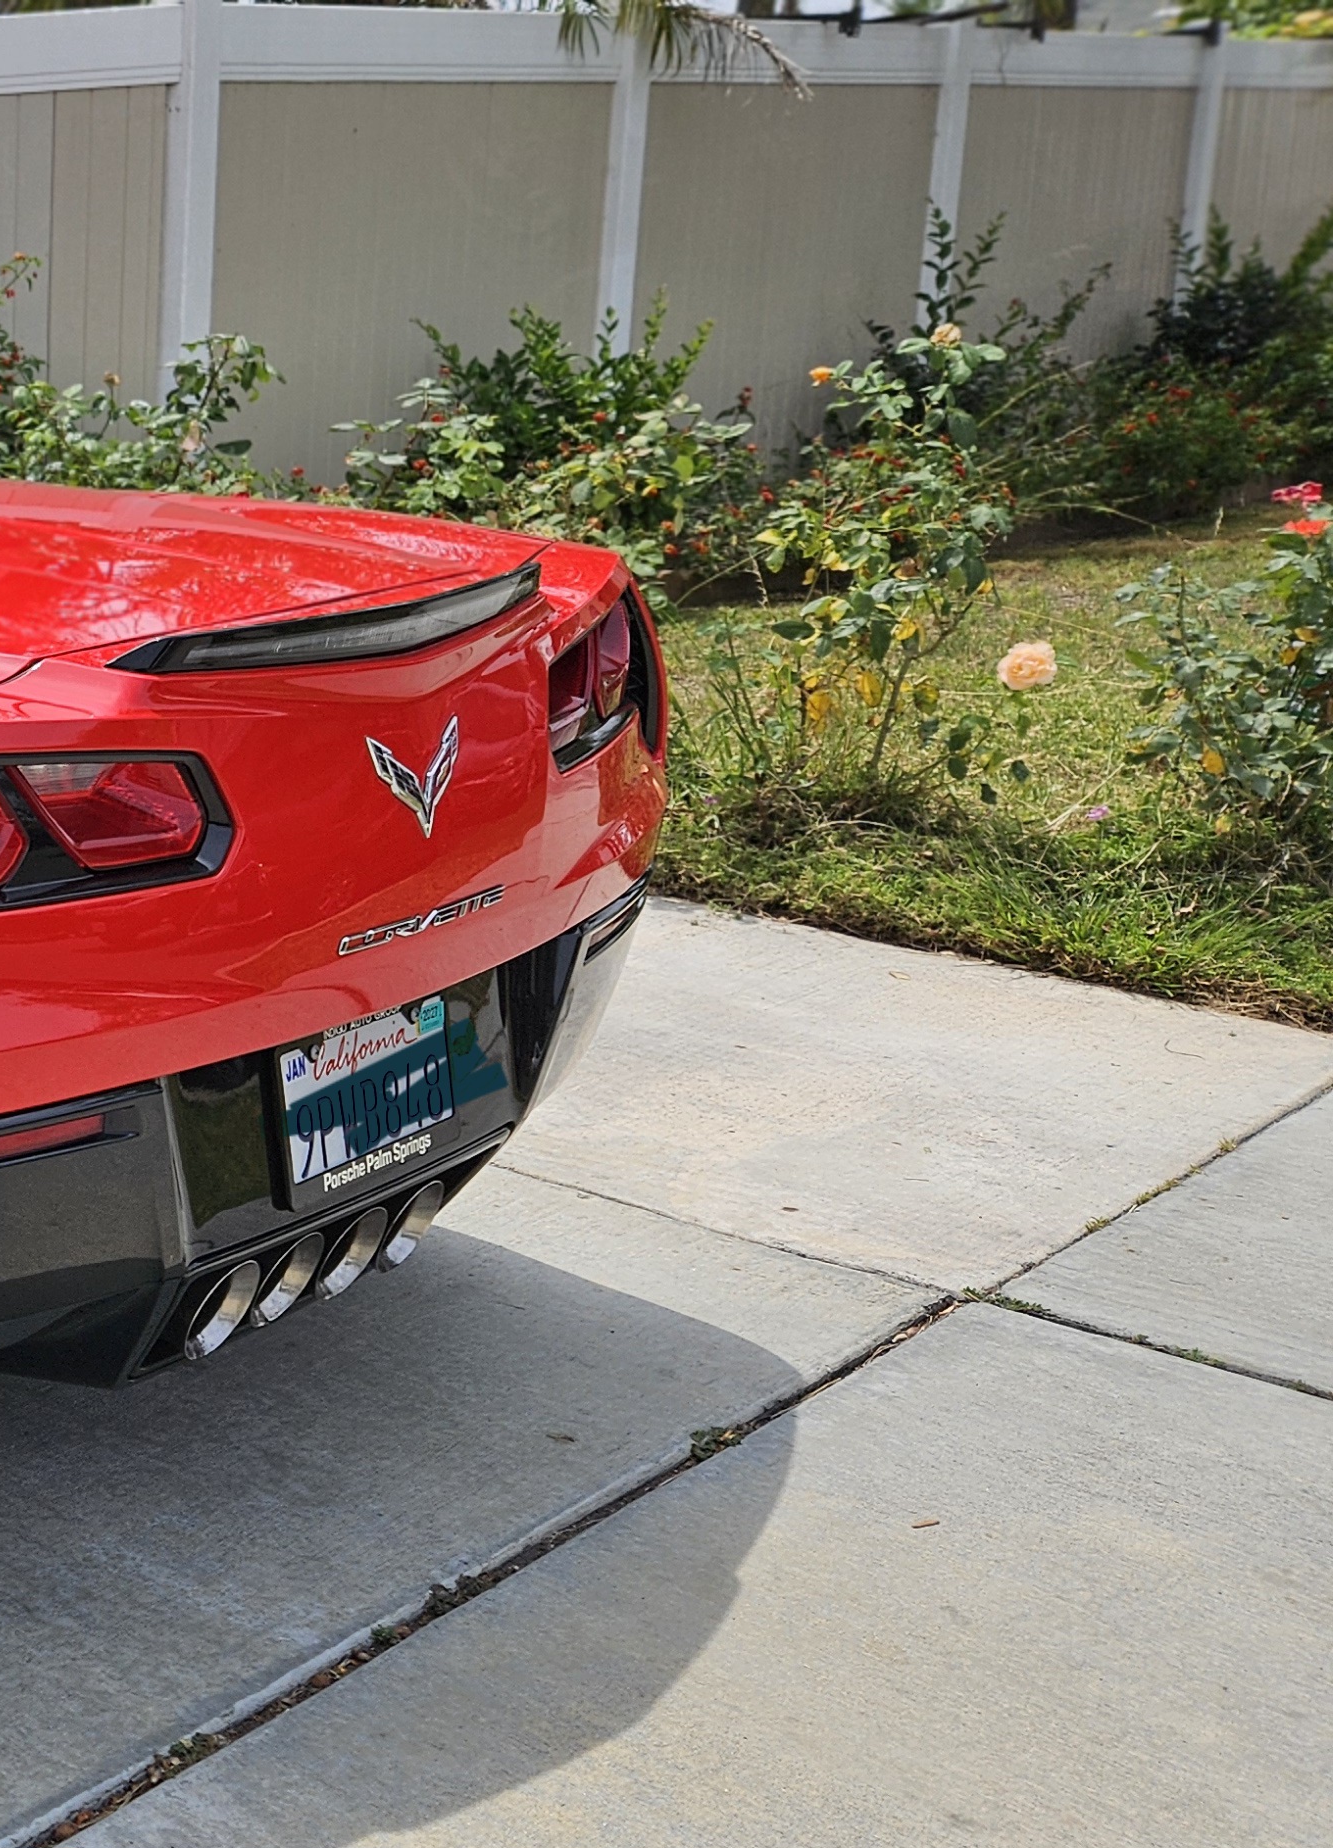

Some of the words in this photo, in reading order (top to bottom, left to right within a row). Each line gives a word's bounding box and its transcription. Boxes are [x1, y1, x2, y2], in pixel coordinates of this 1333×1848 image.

[338, 884, 506, 956] CORVETTE
[285, 1054, 307, 1082] JAN
[313, 1028, 418, 1081] California
[323, 1160, 366, 1192] Porsche
[366, 1149, 393, 1174] Palm
[393, 1133, 432, 1164] Springs
